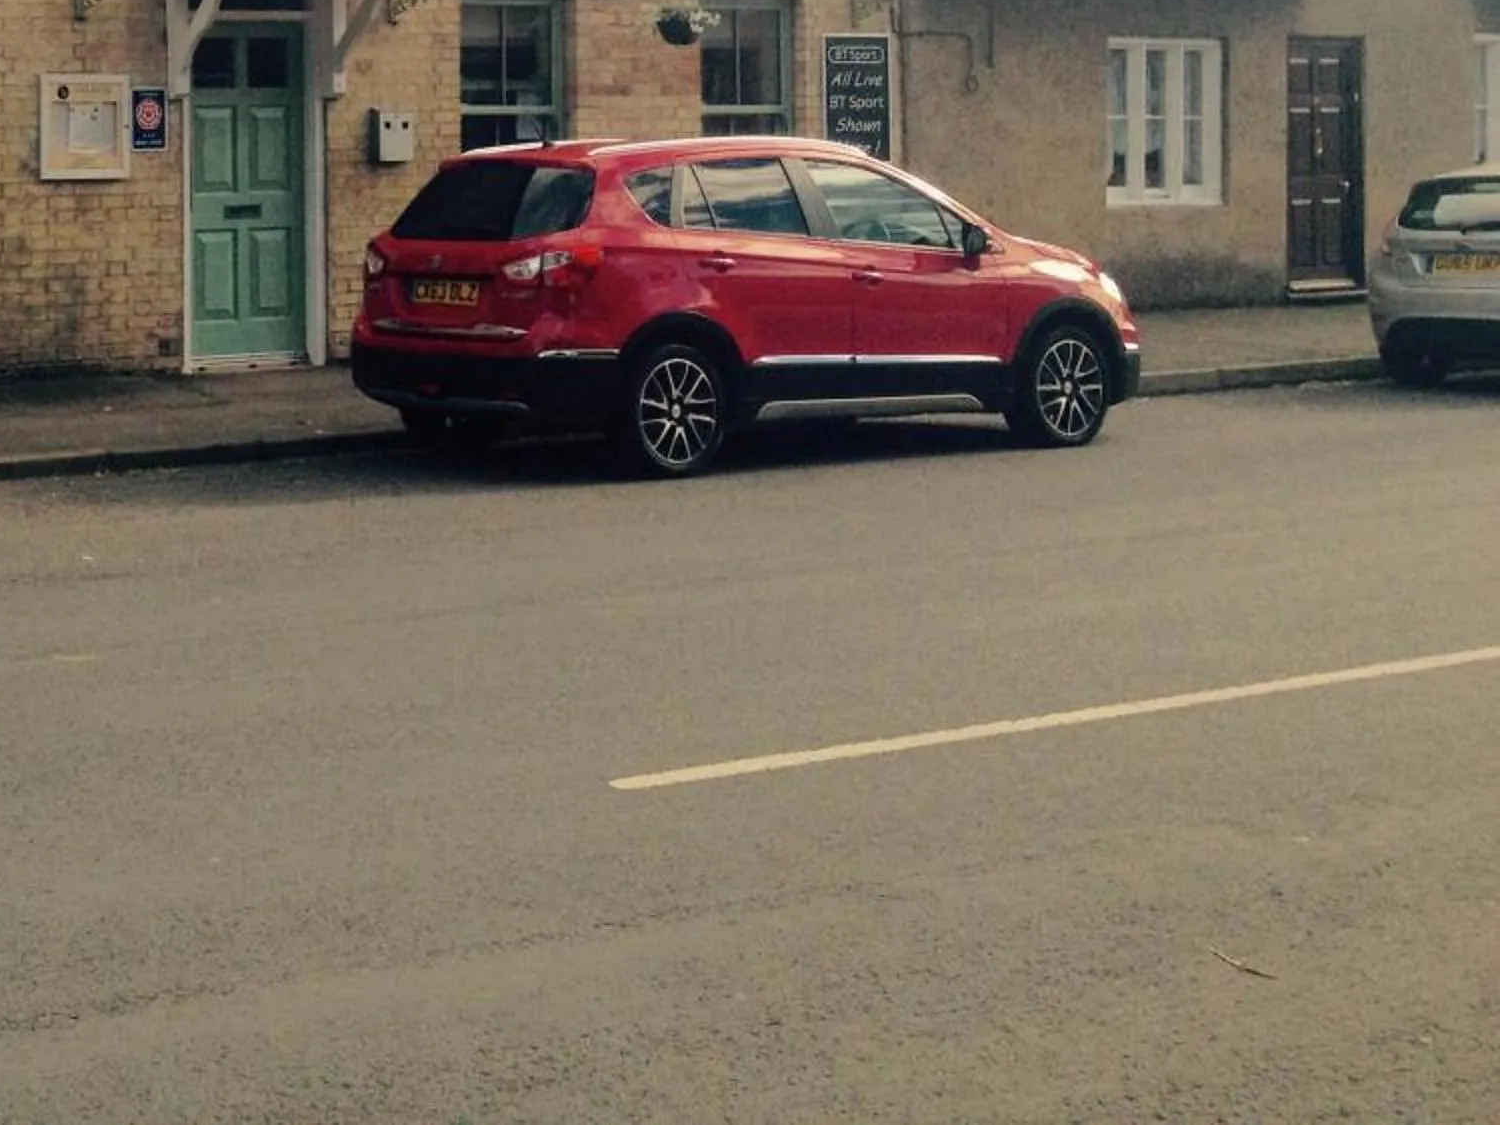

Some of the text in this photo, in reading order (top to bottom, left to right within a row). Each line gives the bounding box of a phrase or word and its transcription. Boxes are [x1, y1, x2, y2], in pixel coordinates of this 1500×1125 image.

[849, 50, 877, 63] Sport
[831, 71, 883, 87] All Live
[829, 95, 884, 111] BT Sport
[835, 117, 882, 132] Shown
